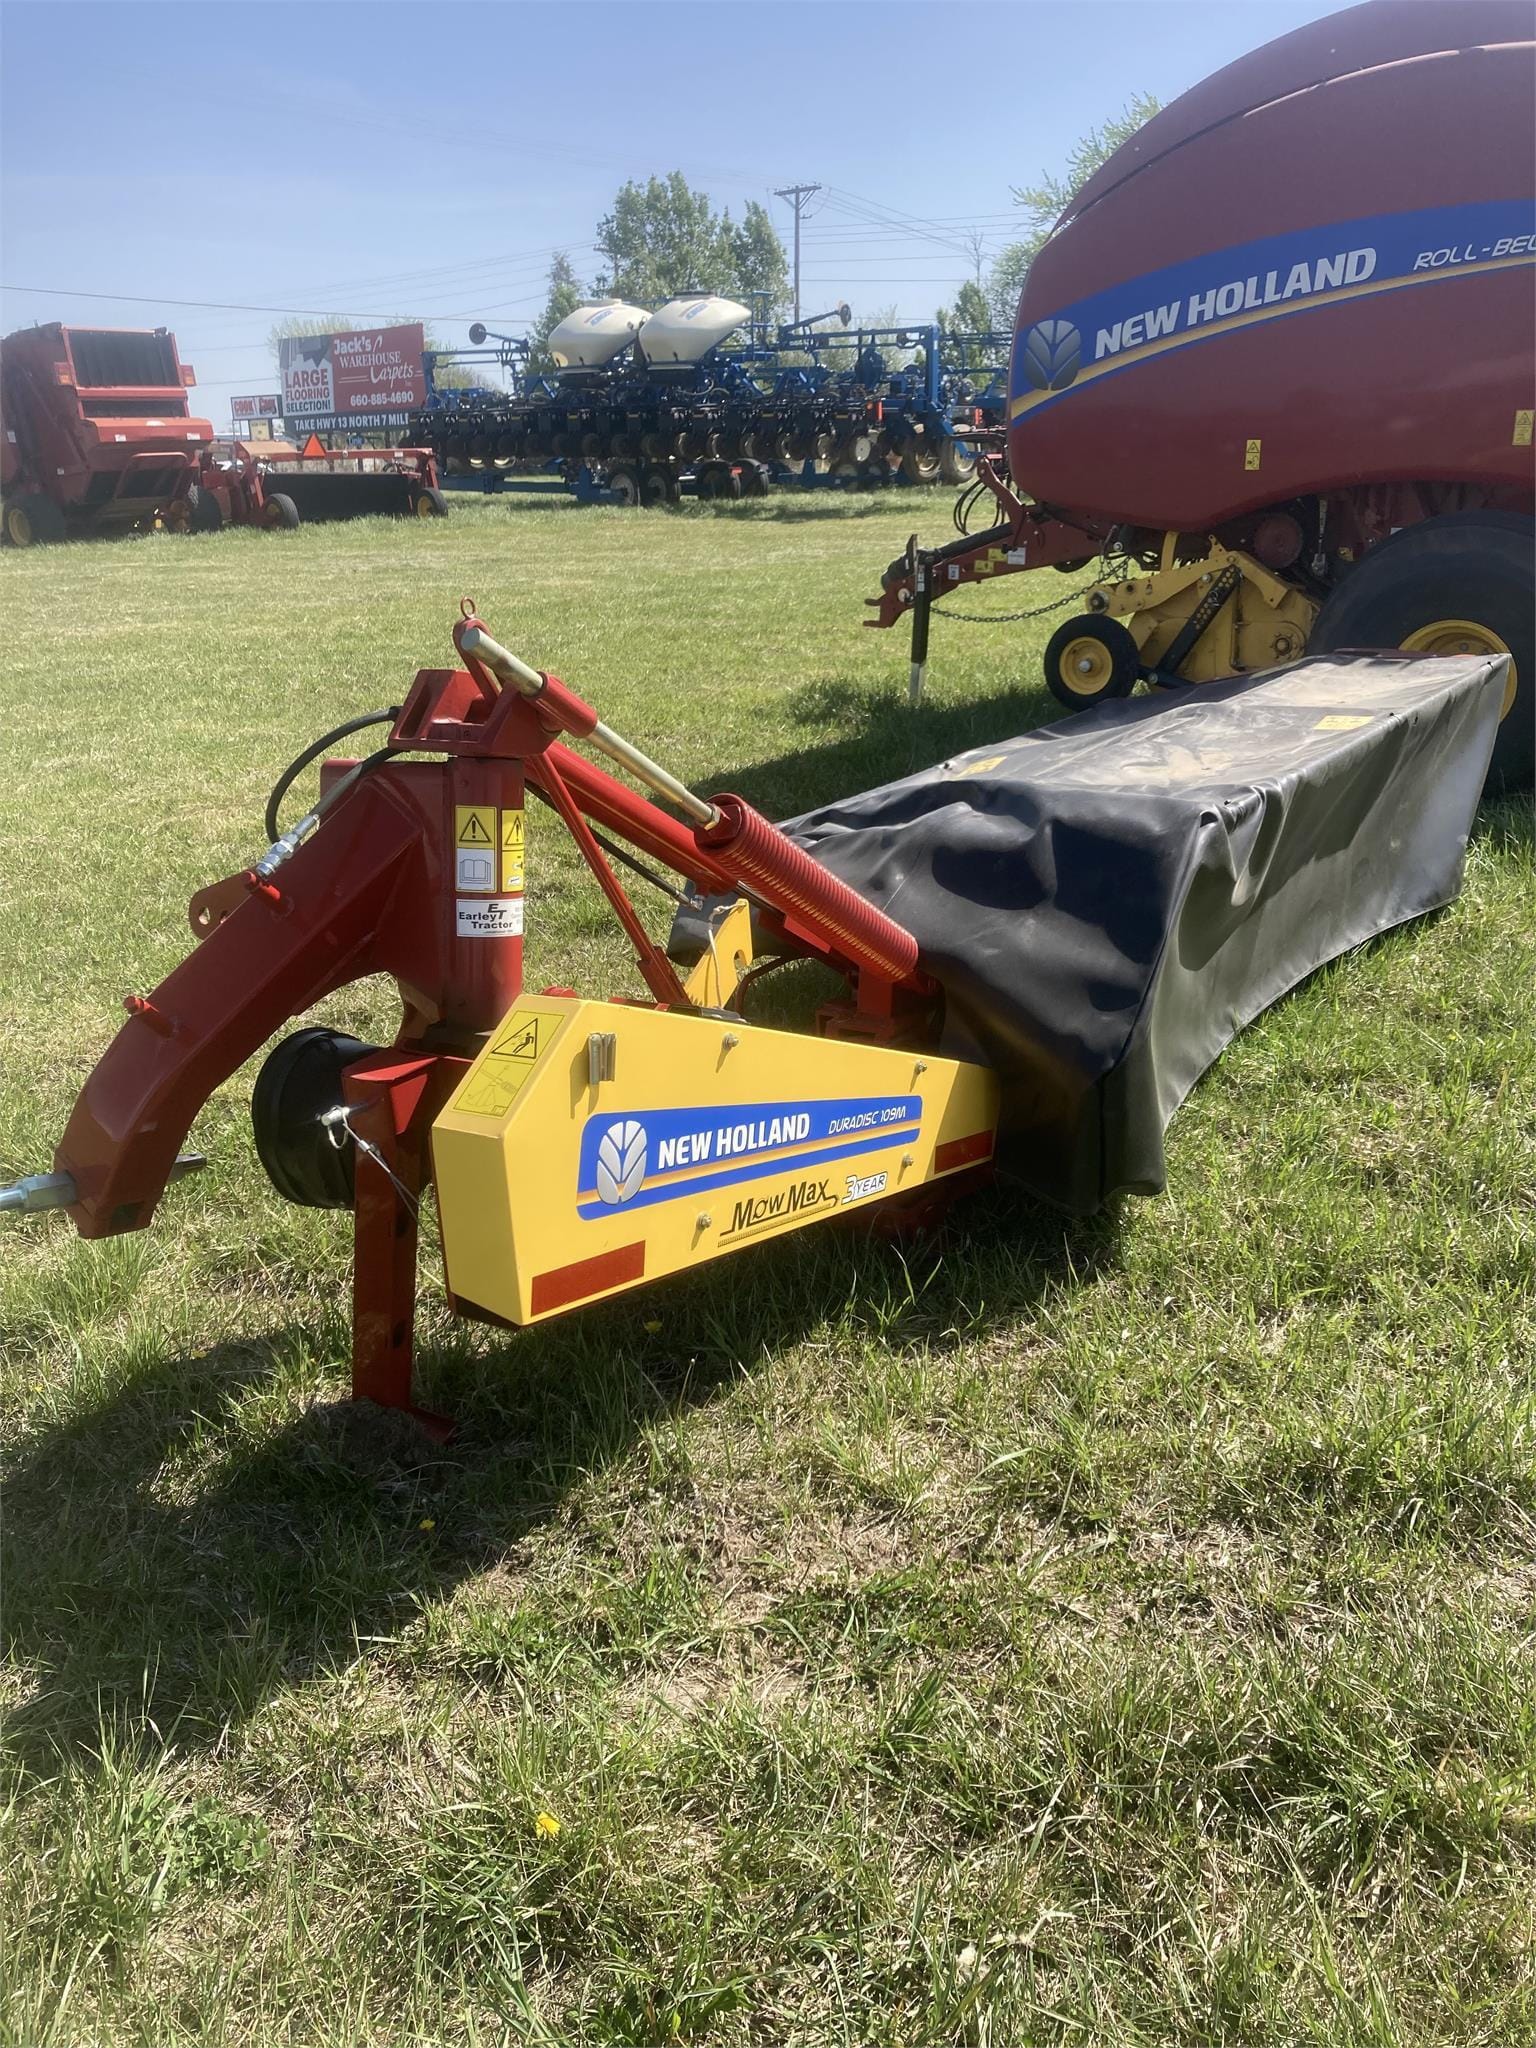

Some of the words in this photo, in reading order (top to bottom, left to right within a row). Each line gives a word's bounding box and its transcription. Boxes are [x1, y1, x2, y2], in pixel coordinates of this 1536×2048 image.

[1095, 300, 1181, 359] NEW
[1187, 246, 1377, 326] HOLLAND
[334, 336, 372, 355] Jack's
[339, 351, 401, 369] WAREHOUSE
[284, 367, 329, 389] LARGE
[370, 361, 414, 389] Carpets
[285, 387, 330, 401] FLOORING
[286, 399, 331, 414] SELECTION!
[294, 418, 316, 432] TAKE
[316, 416, 337, 431] HWY
[338, 415, 347, 429] 13
[349, 413, 380, 428] NORTH
[381, 413, 387, 427] 7
[459, 912, 497, 922] Earley
[471, 921, 513, 929] Tractor
[658, 1130, 714, 1169] NEW
[716, 1113, 811, 1156] HOLLAND
[828, 1110, 879, 1135] DURADISC
[880, 1105, 906, 1123] 109M
[856, 1175, 886, 1195] YEAR
